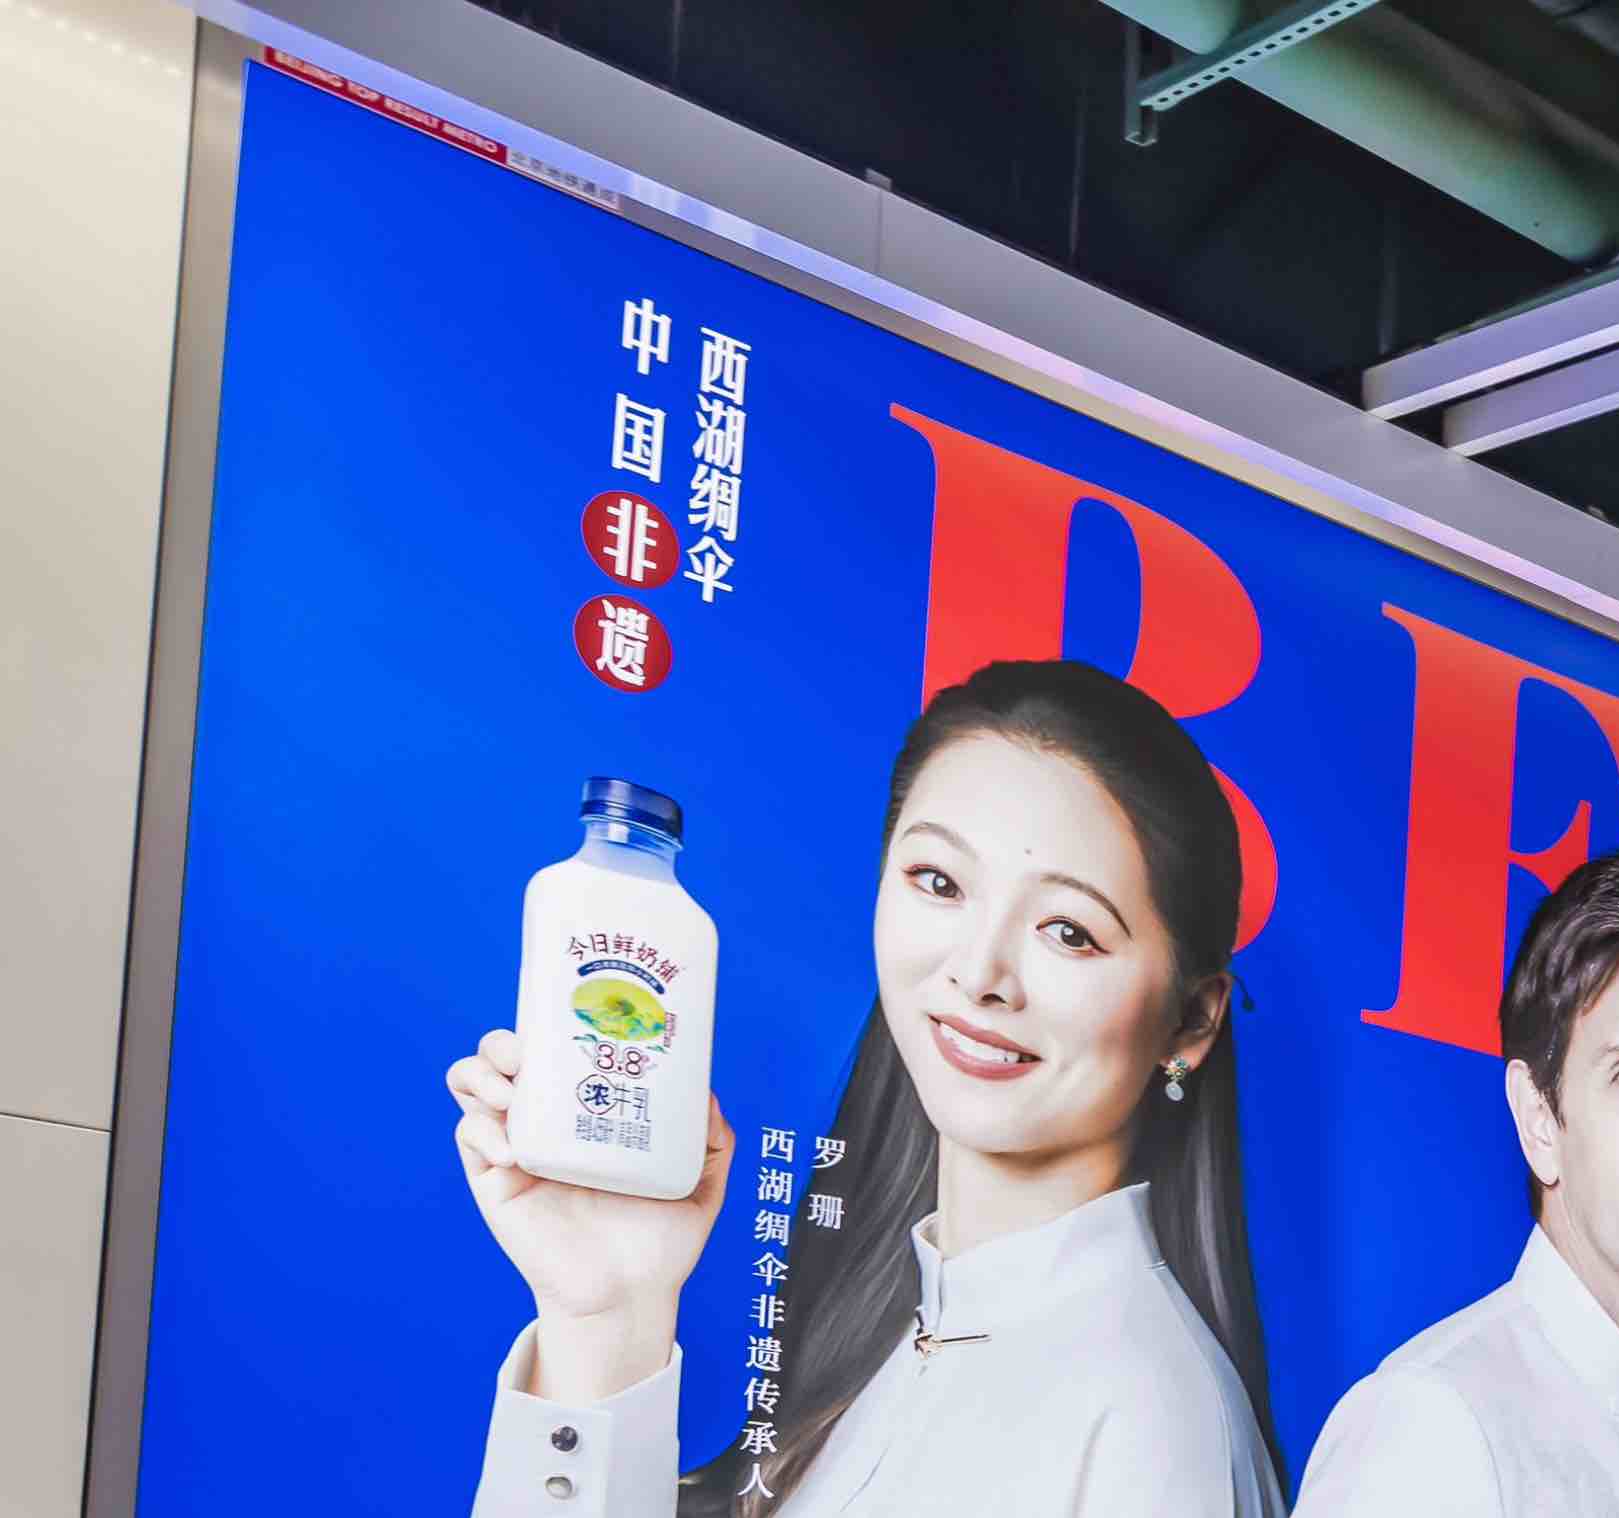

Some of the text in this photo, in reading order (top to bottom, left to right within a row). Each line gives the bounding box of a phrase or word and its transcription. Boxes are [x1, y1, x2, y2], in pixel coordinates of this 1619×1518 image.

[595, 297, 671, 687] 中国非遗
[684, 326, 752, 604] 西湖绸伞
[737, 1126, 797, 1499] 西湖绸伞非遗传承人
[806, 1135, 847, 1231] 罗珊
